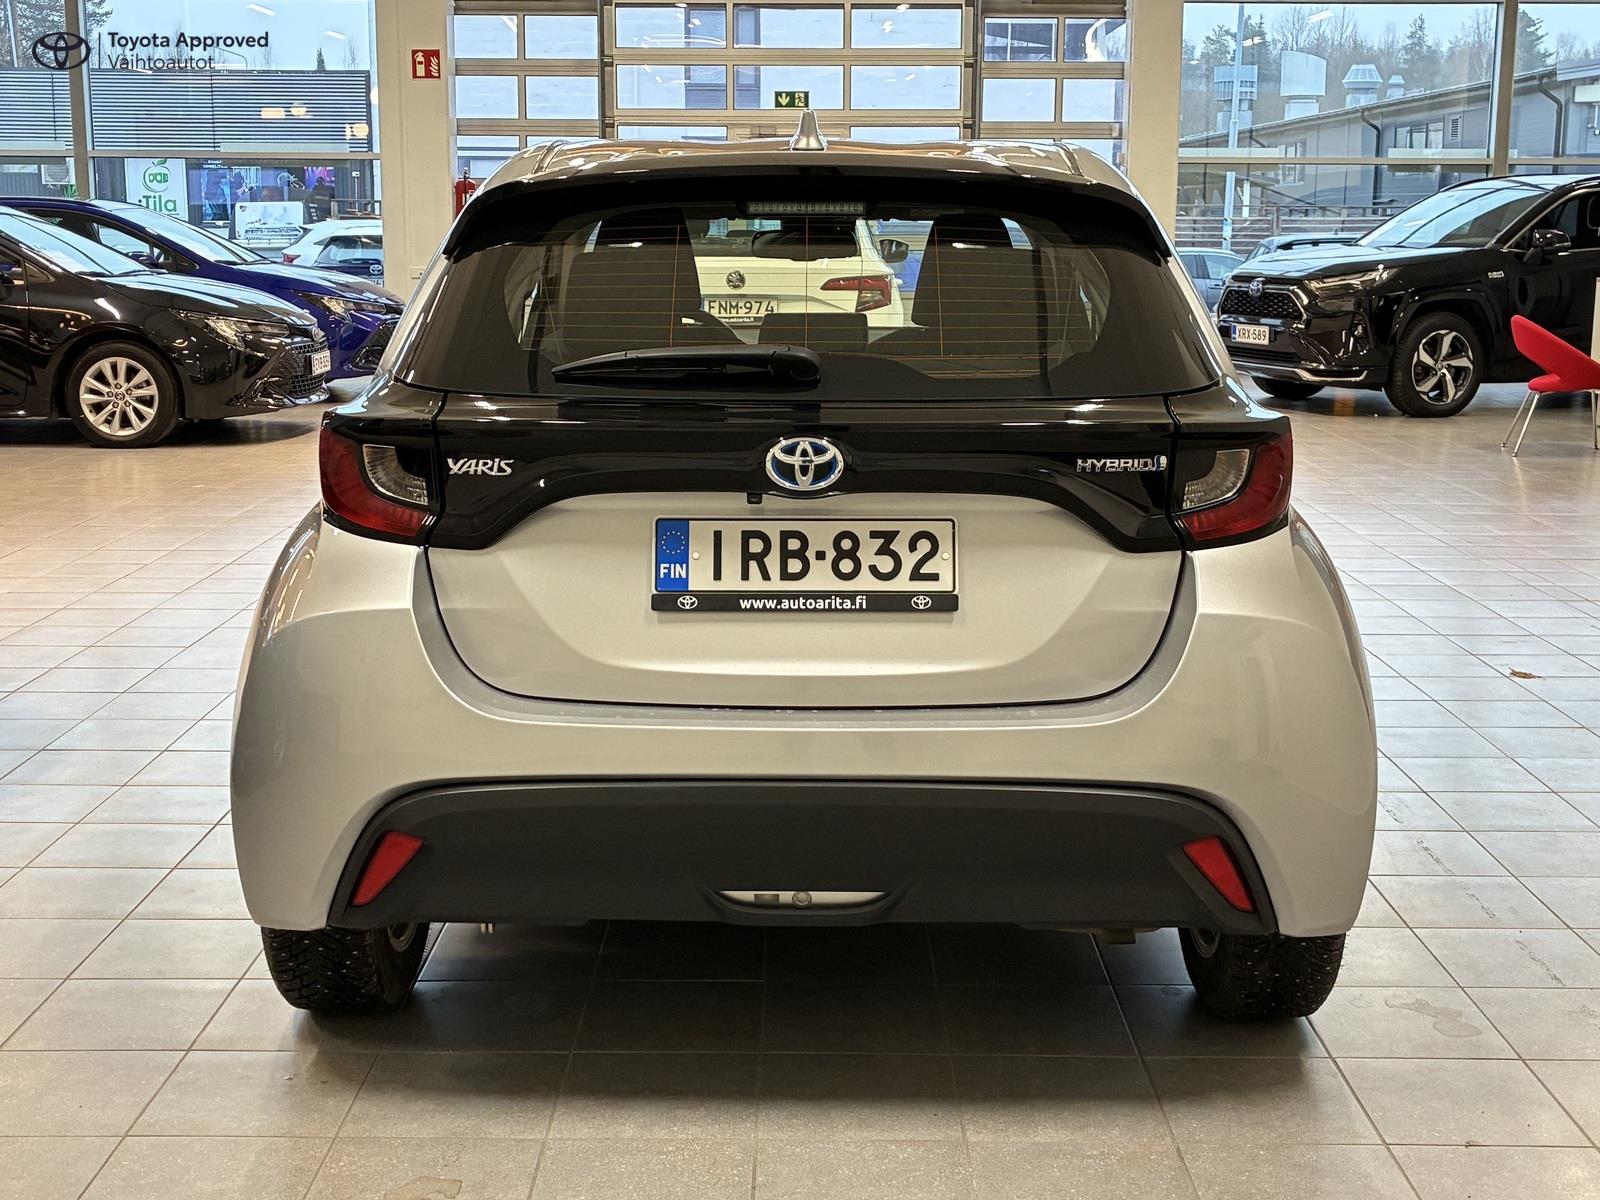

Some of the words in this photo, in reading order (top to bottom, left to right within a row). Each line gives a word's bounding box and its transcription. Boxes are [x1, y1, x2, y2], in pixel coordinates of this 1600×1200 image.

[708, 300, 775, 315] FNM-974
[1237, 327, 1267, 341] XRX-589
[446, 458, 515, 476] YARIS
[1076, 458, 1154, 473] HYBRID
[712, 529, 941, 582] IRB-832
[659, 563, 687, 579] FIN
[739, 595, 867, 610] www.autoarita.fi
